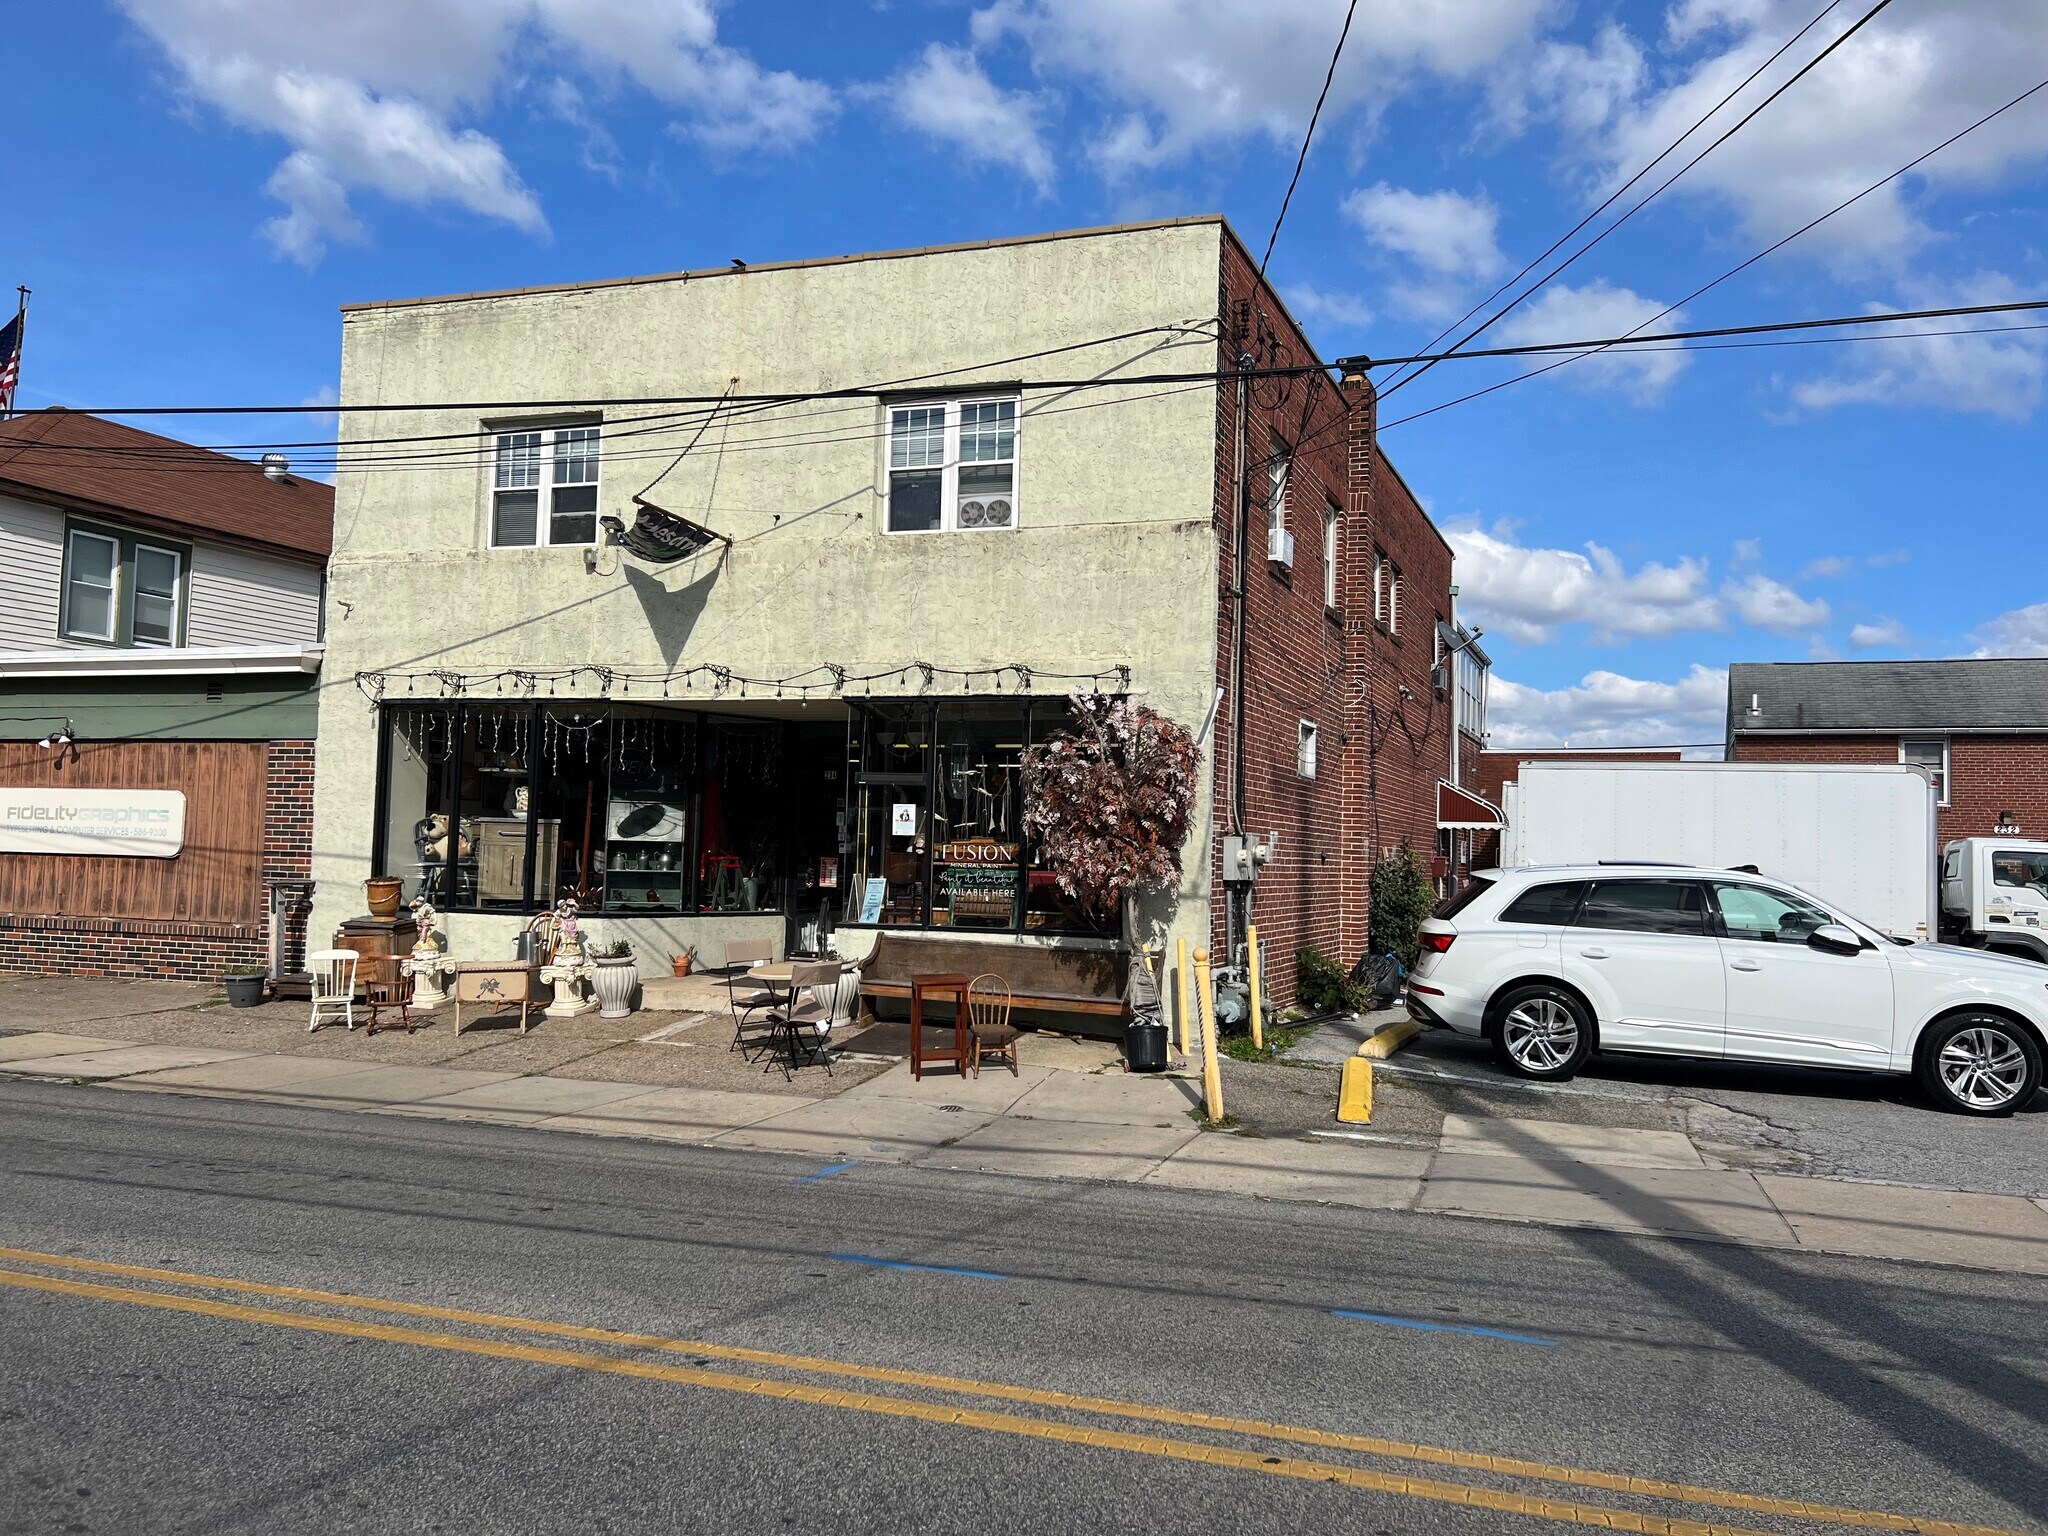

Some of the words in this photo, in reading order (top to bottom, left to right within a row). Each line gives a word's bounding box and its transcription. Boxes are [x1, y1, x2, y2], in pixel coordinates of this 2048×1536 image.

[56, 825, 95, 835] COMPUTER
[96, 826, 130, 837] SERVICES
[1997, 825, 2016, 834] 232
[942, 844, 1012, 861] FUSION
[964, 873, 973, 884] it
[939, 887, 989, 897] AVAILABLE
[992, 889, 1015, 898] HERE
